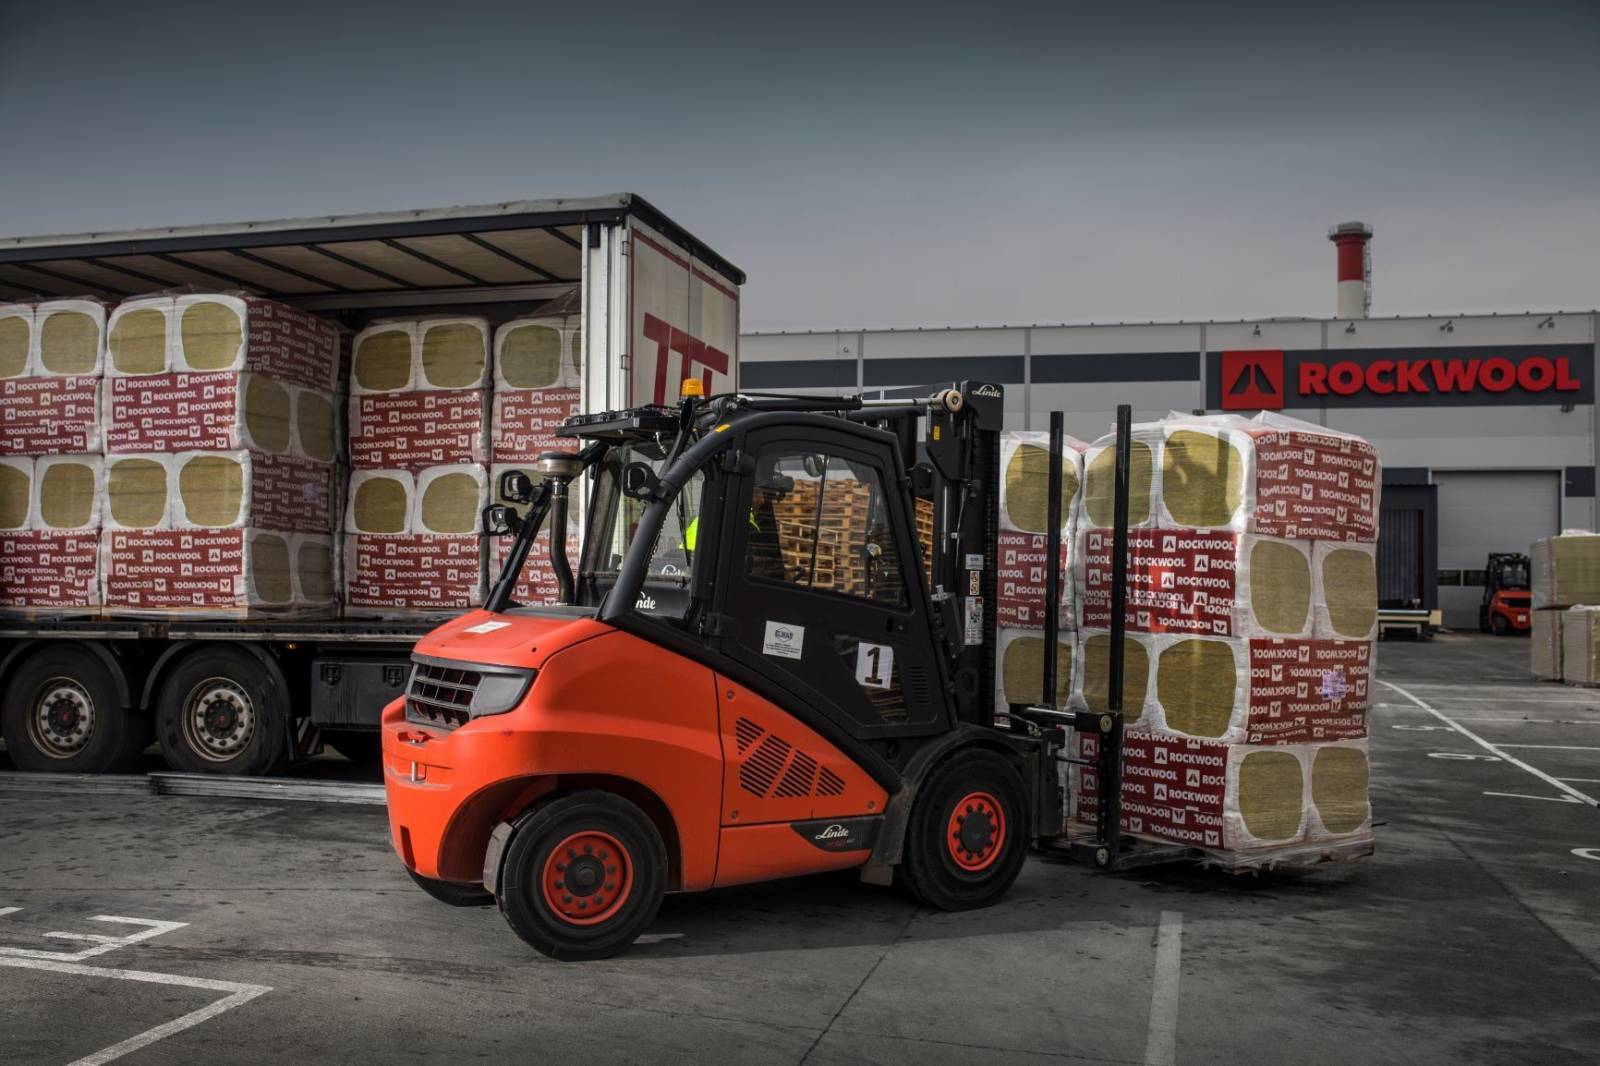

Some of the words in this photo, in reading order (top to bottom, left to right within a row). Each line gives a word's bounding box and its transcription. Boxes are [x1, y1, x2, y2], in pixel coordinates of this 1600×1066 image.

[128, 379, 170, 388] ROCKWOOL
[190, 372, 234, 384] ROCKWOOL
[1298, 356, 1581, 395] ROCKWOOL
[154, 391, 197, 400] ROCKWOOL
[972, 384, 1001, 398] Linde
[128, 407, 171, 415] ROCKWOOL
[190, 400, 233, 411] ROCKWOOL
[376, 400, 418, 408] ROCKWOOL
[401, 412, 444, 420] ROCKWOOL
[517, 407, 562, 415] ROCKWOOL
[376, 426, 418, 434] ROCKWOOL
[1294, 468, 1337, 481] ROCKWOOL
[128, 538, 174, 546] ROCKWOOL
[194, 537, 240, 546] ROCKWOOL
[1178, 540, 1234, 550] ROCKWOOL
[156, 552, 202, 560] ROCKWOOL
[372, 558, 415, 566] ROCKWOOL
[1133, 557, 1186, 567] ROCKWOOL
[194, 565, 238, 573] ROCKWOOL
[1177, 576, 1230, 589] ROCKWOOL
[636, 592, 656, 610] nde
[1159, 617, 1211, 630] ROCKWOOL
[1253, 649, 1297, 659] ROCKWOOL
[1317, 650, 1356, 658] ROCKWOOL
[865, 647, 882, 684] 1
[1252, 687, 1296, 696] ROCKWOOL
[1169, 752, 1223, 766] ROCKWOOL
[1126, 765, 1178, 780] ROCKWOOL
[1169, 789, 1220, 804] ROCKWOOL
[814, 824, 850, 840] Linde
[1151, 823, 1202, 841] ROCKWOOL
